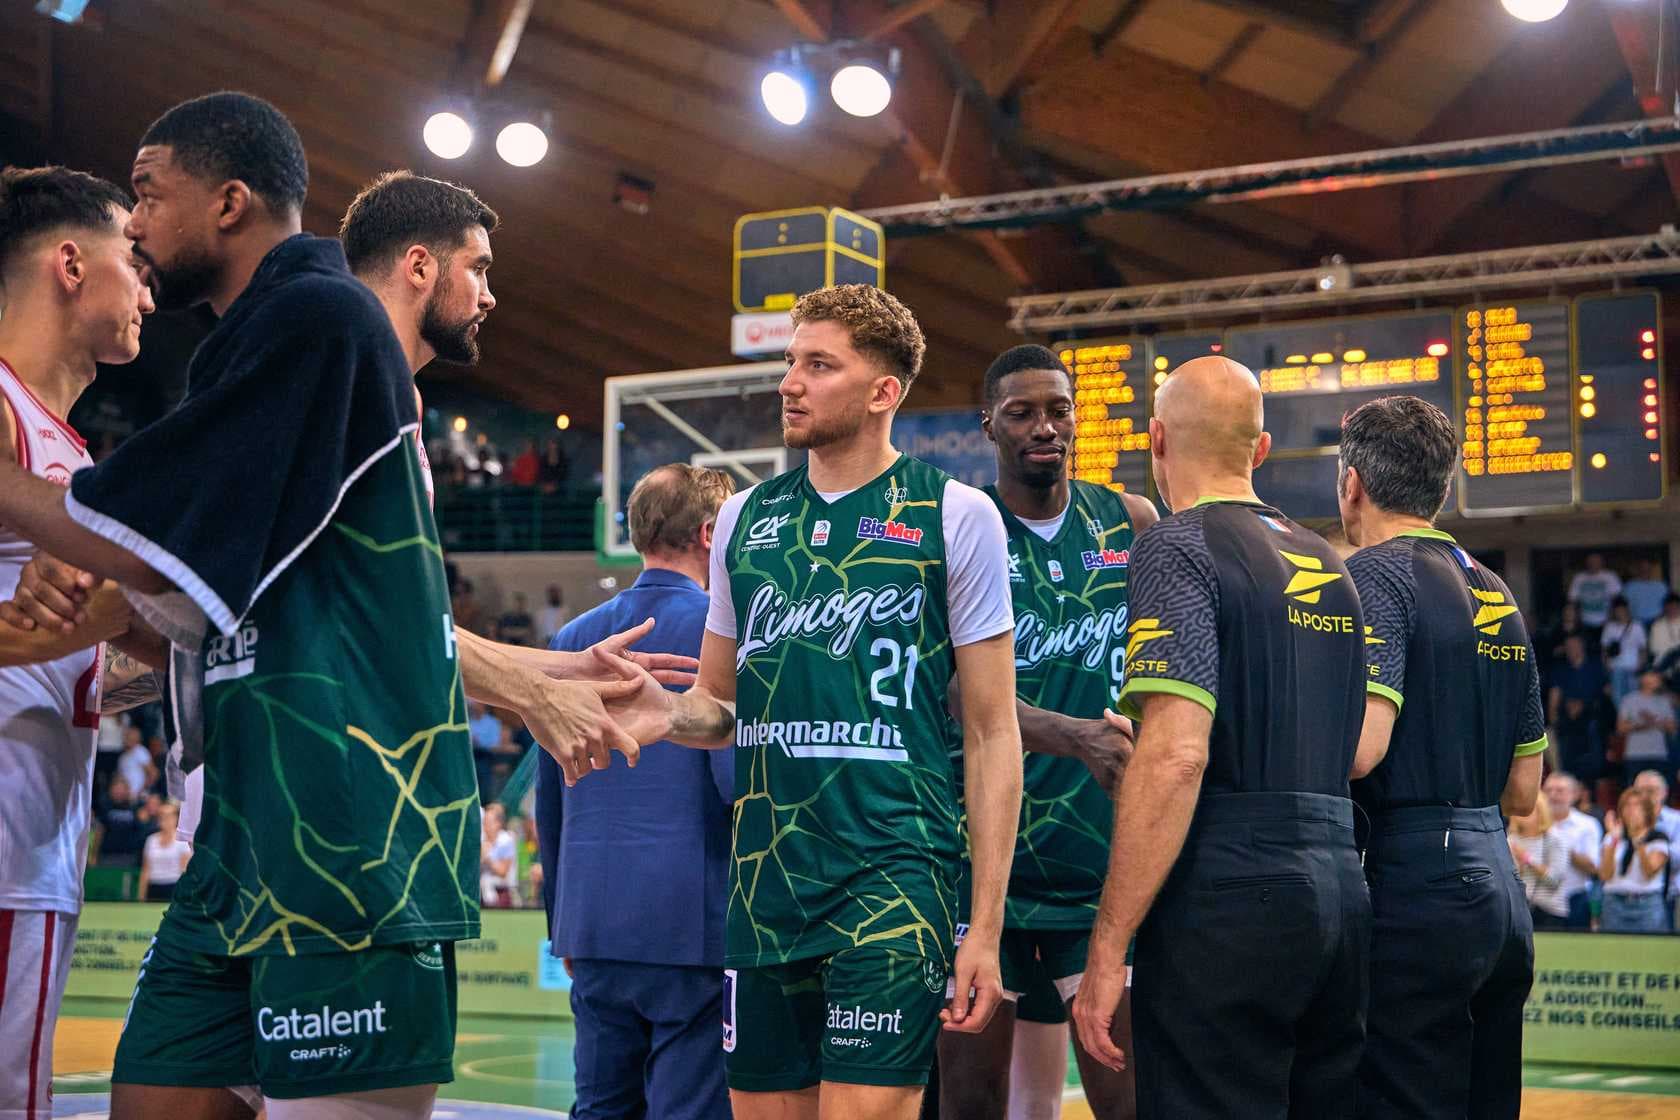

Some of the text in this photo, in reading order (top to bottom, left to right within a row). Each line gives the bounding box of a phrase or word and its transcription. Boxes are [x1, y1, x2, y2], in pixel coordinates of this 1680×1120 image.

[749, 512, 791, 539] CA
[857, 516, 923, 546] BigMat
[1081, 549, 1130, 570] BigMat
[737, 582, 924, 669] Limoges
[1288, 605, 1354, 633] LA POSTE
[1014, 604, 1129, 669] Limoge
[870, 637, 918, 710] 21
[1126, 659, 1169, 673] OSTE
[258, 1000, 387, 1041] Catalent
[826, 1003, 903, 1034] atalent
[290, 1046, 337, 1061] CRAFT
[831, 1037, 861, 1047] CRAFT
